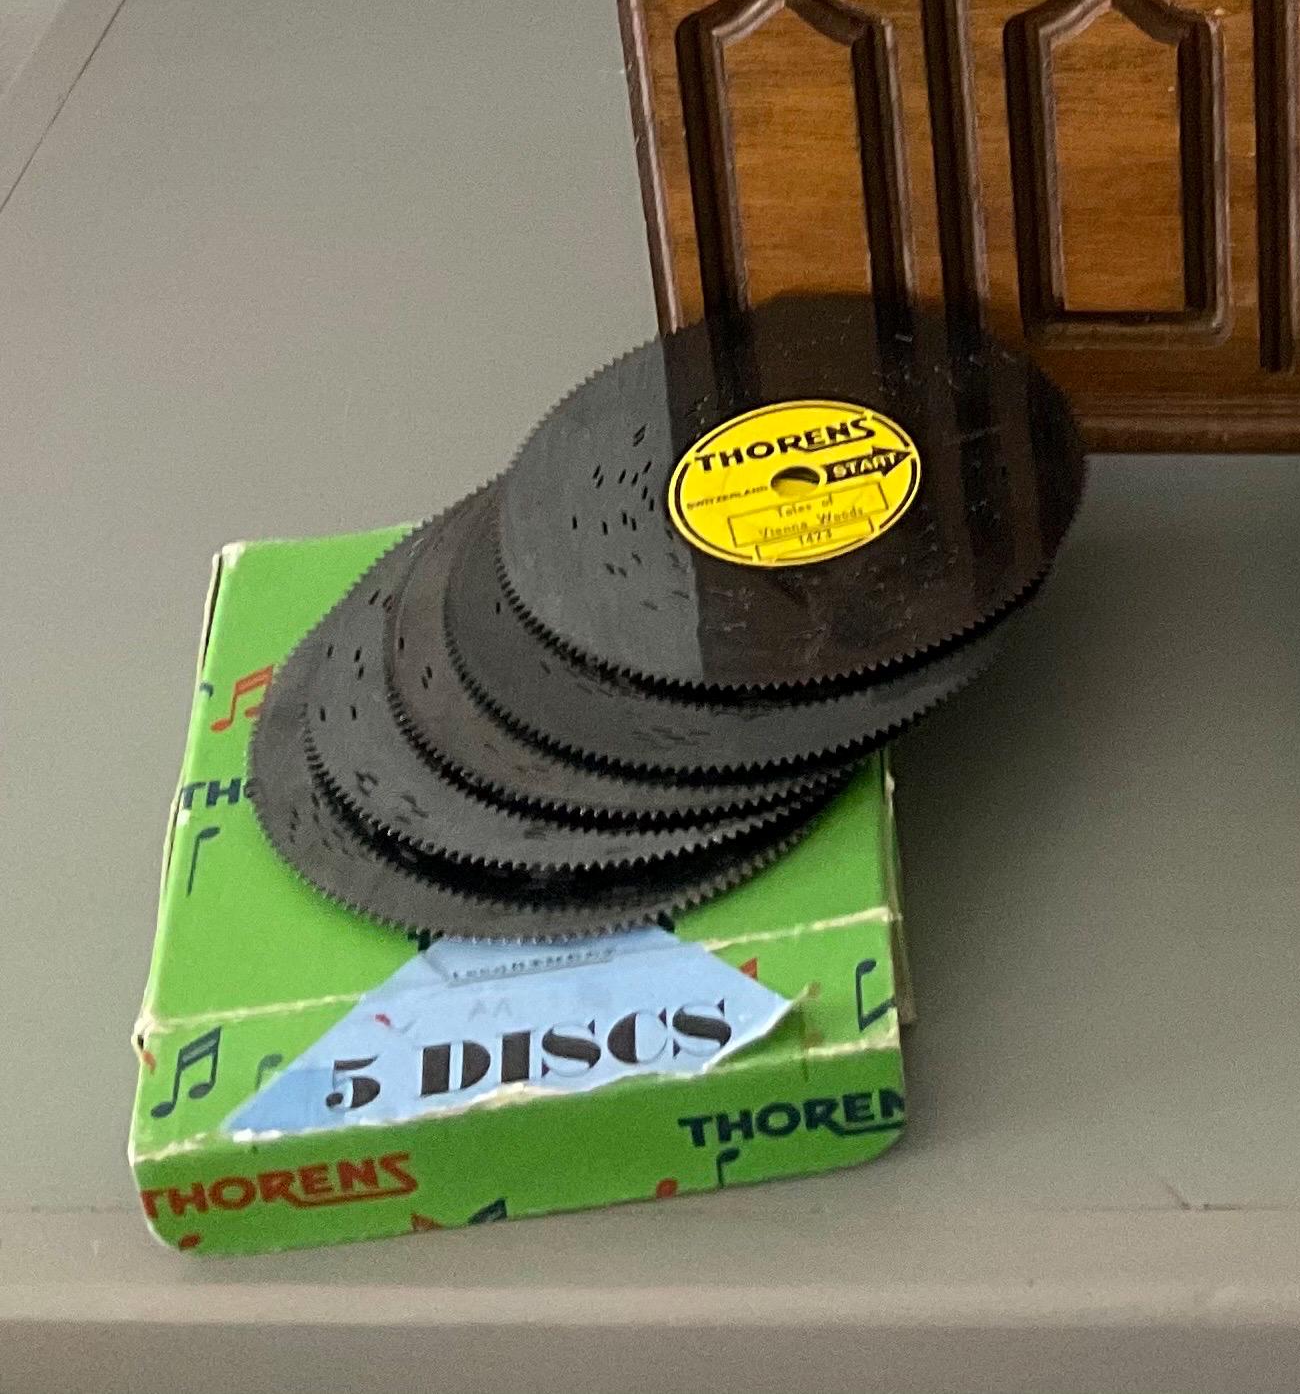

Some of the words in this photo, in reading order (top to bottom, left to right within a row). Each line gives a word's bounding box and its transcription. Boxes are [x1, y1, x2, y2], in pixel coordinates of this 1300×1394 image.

[695, 417, 875, 472] THORENS
[832, 452, 896, 478] START
[758, 521, 808, 539] Vienna
[816, 507, 863, 525] Woods
[778, 503, 812, 518] Tales
[821, 492, 833, 507] of
[325, 1054, 380, 1110] 5
[418, 998, 733, 1097] DISCS
[677, 1087, 906, 1148] THOREN
[140, 1152, 419, 1219] THORENS
